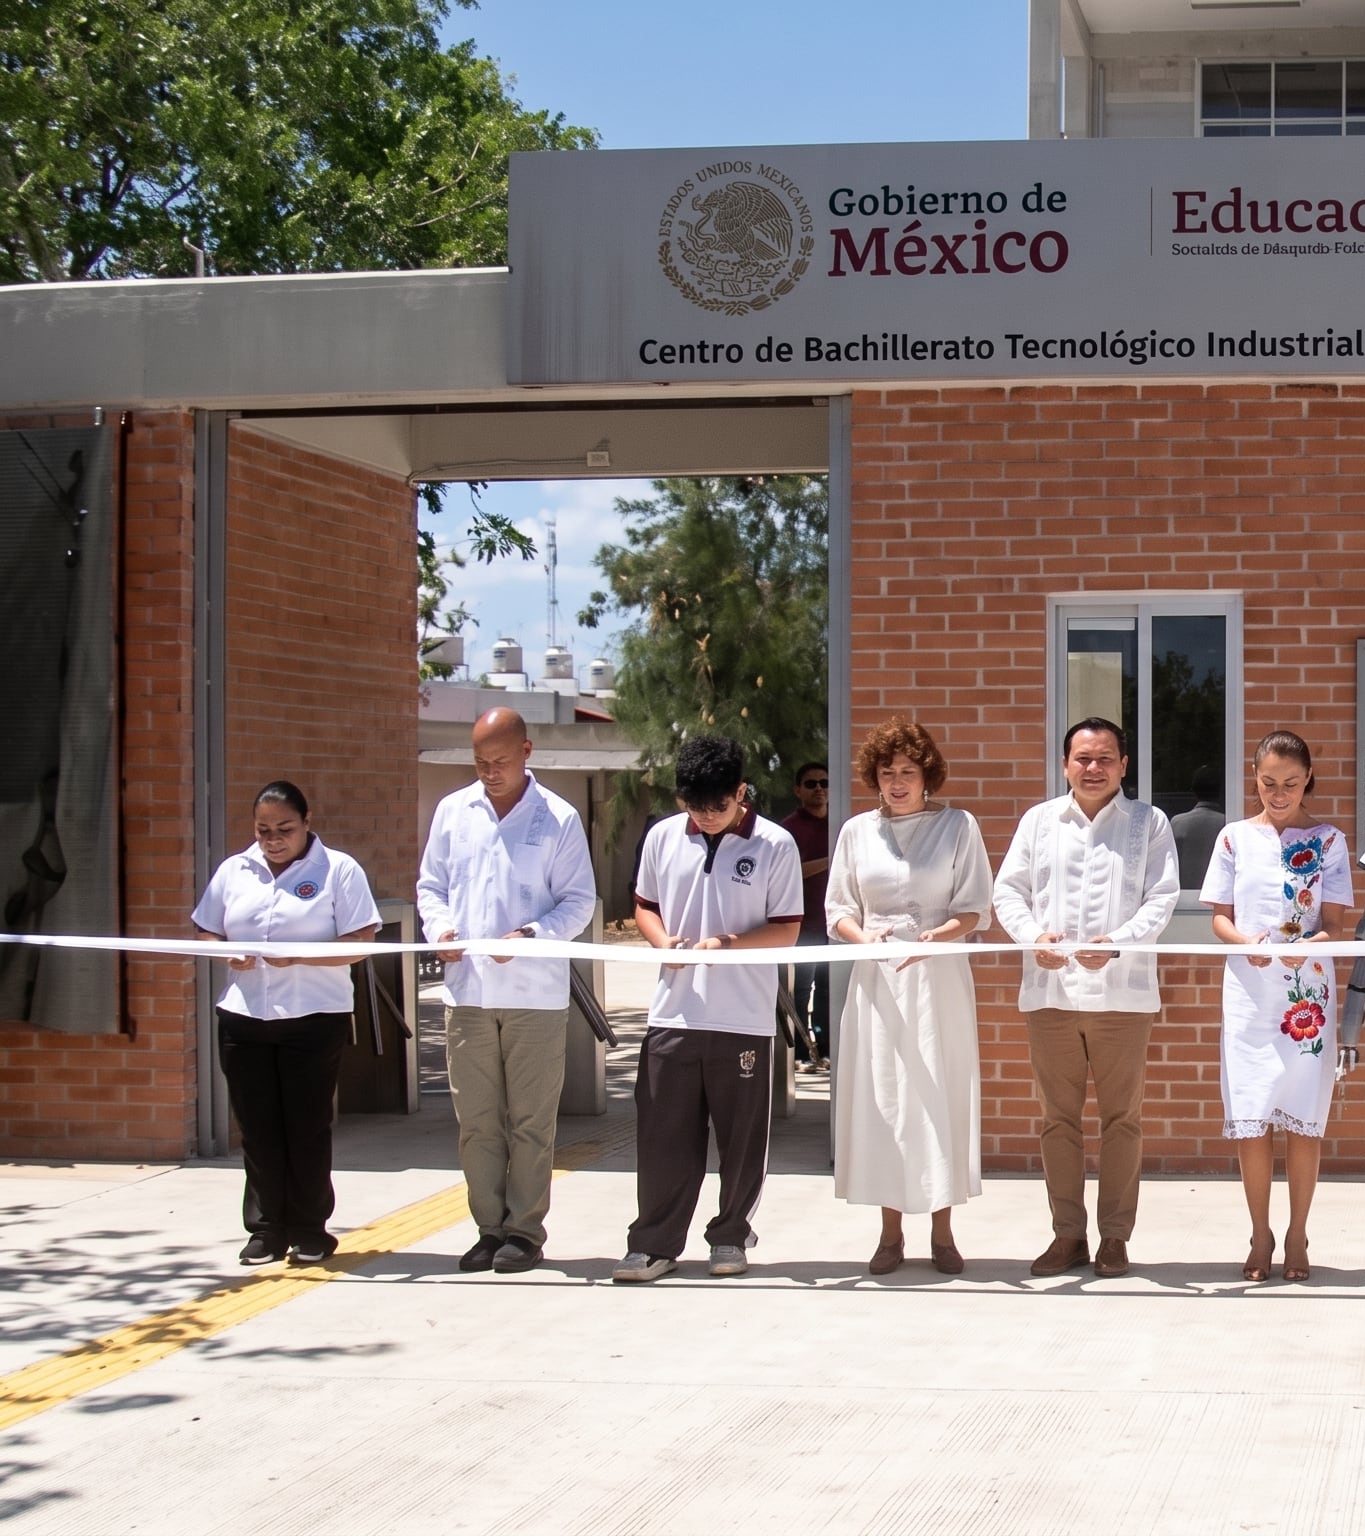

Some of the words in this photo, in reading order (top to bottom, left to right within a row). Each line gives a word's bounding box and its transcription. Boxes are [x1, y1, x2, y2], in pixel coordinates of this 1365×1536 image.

[658, 179, 695, 237] ESTADOS
[695, 161, 752, 183] UNIDOS
[757, 163, 814, 233] MEXICANOS
[829, 185, 1007, 217] Gobierno
[1022, 182, 1067, 213] de
[828, 219, 1069, 277] México
[1241, 243, 1260, 255] de
[639, 338, 743, 365] Centro
[755, 335, 793, 363] de
[804, 332, 995, 362] Bachillerato
[1004, 330, 1196, 366] Tecnológico
[1208, 327, 1365, 357] Industrial
